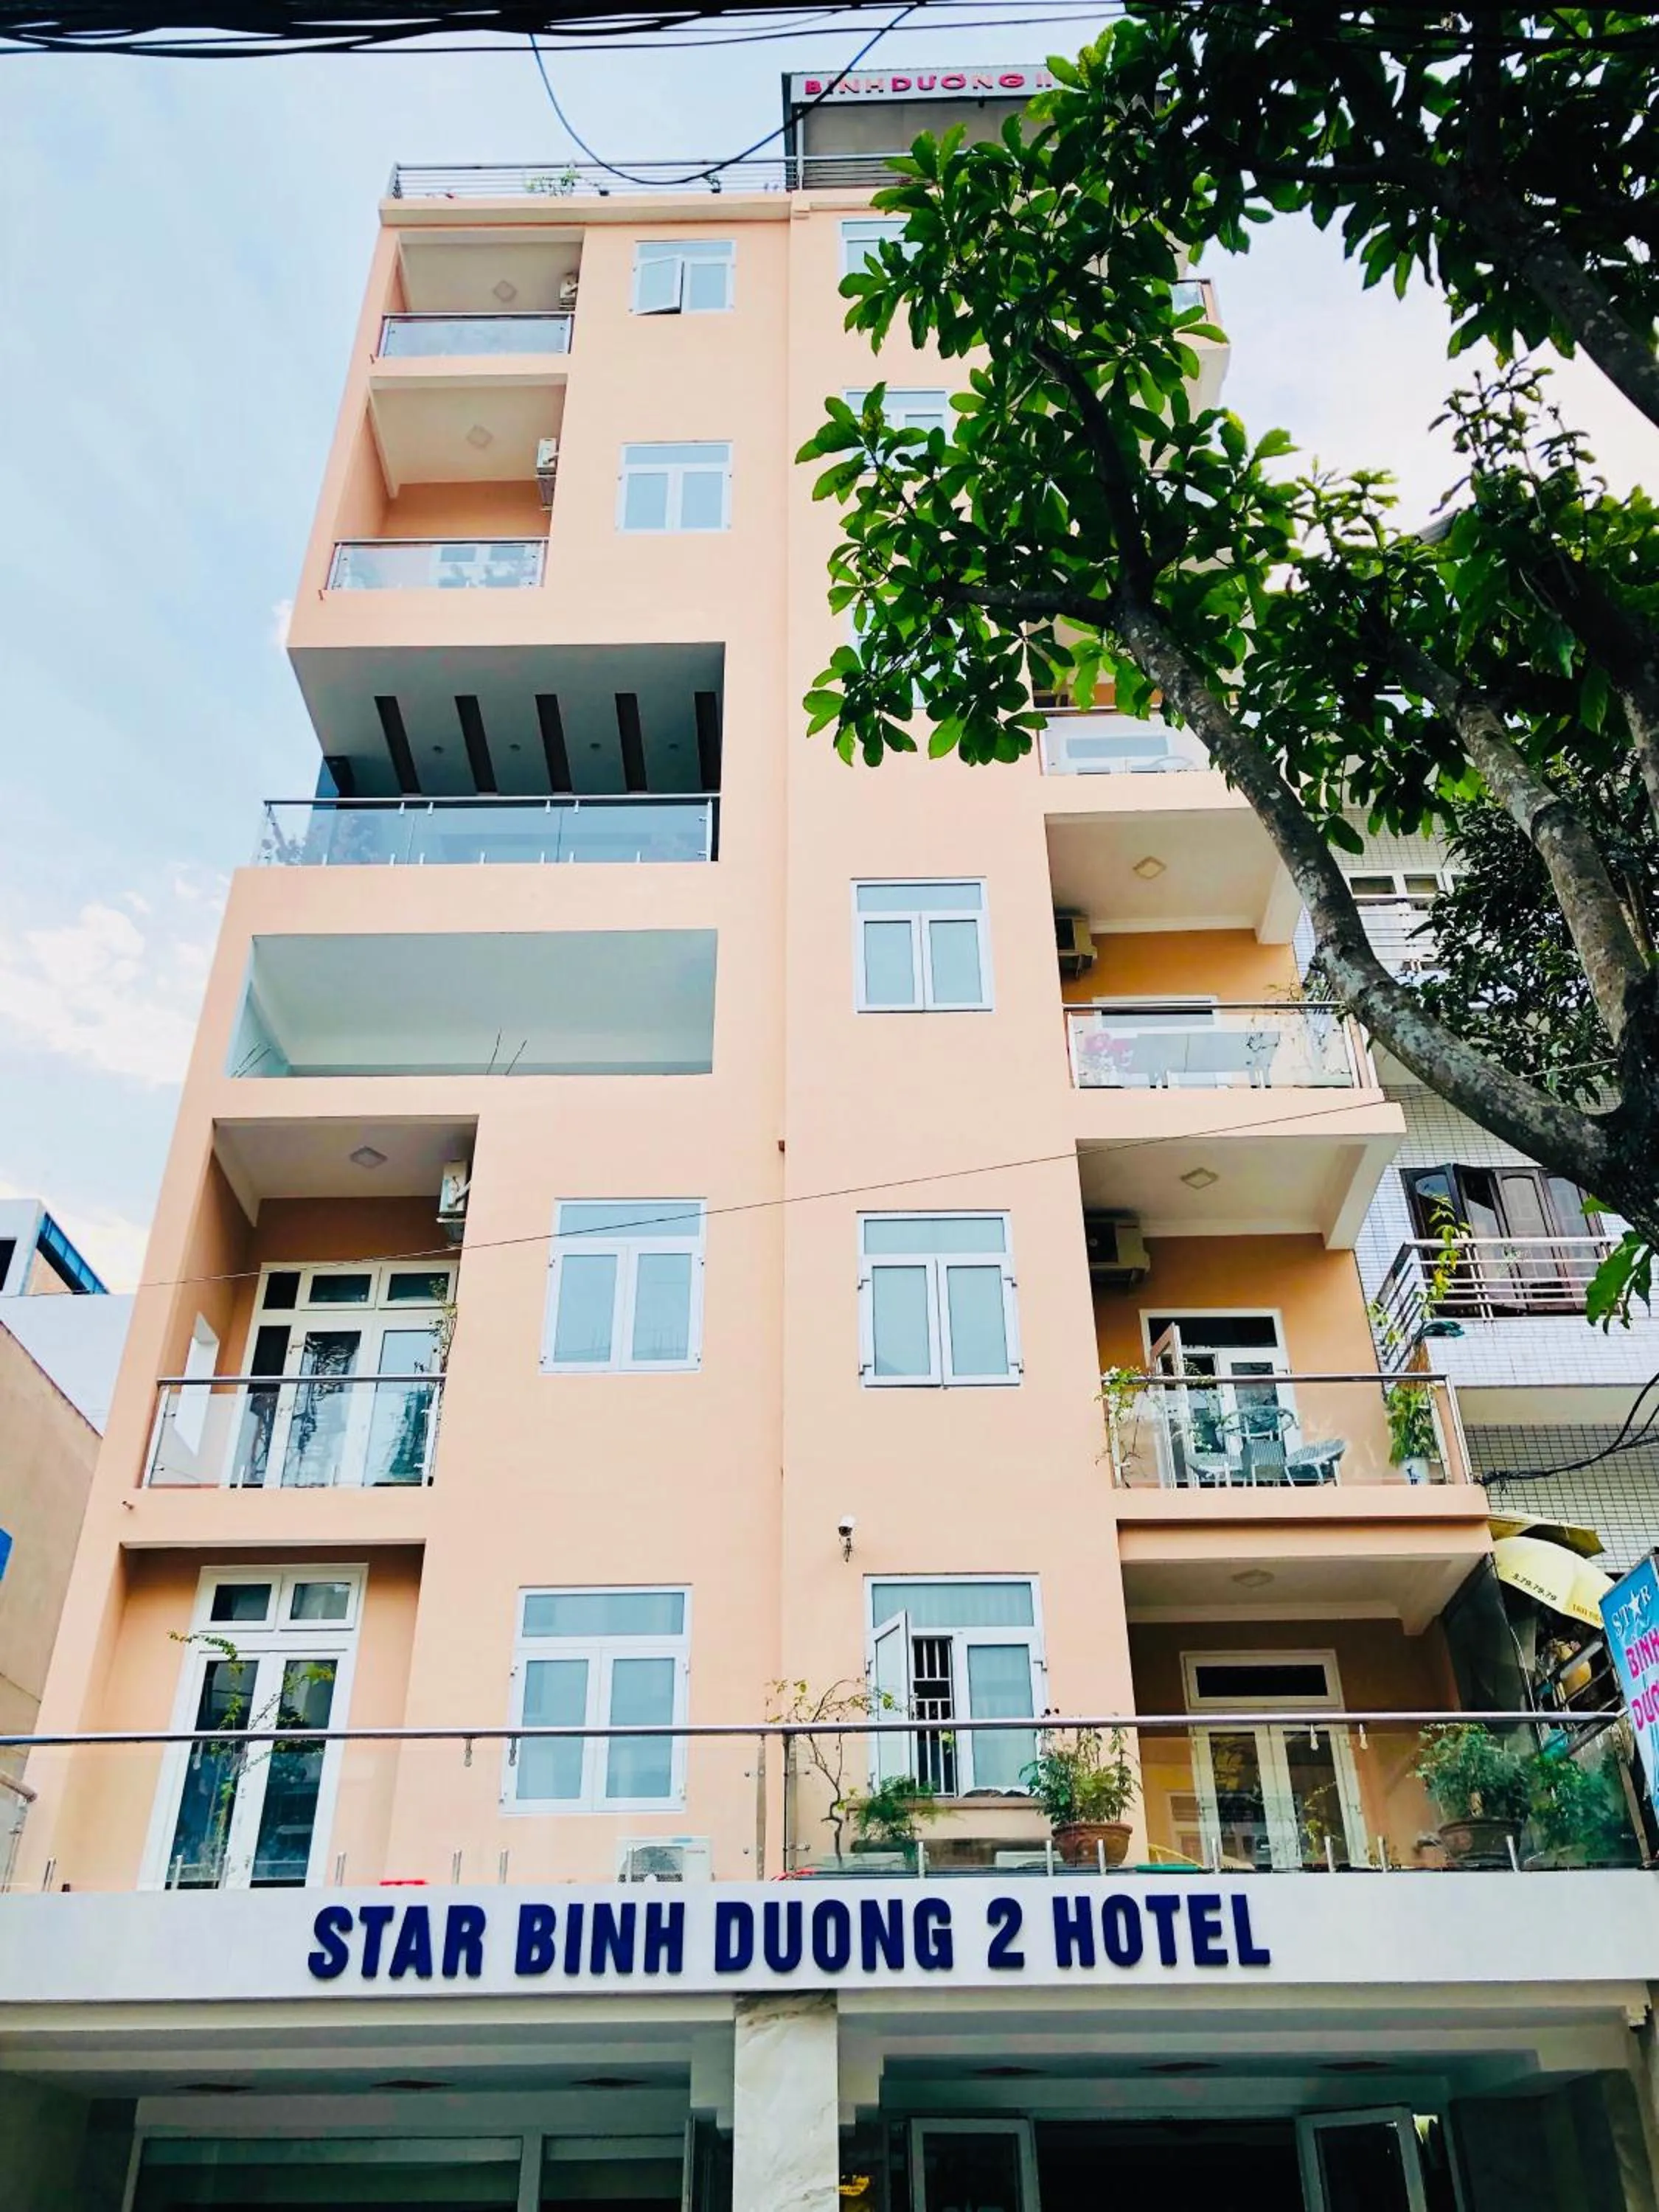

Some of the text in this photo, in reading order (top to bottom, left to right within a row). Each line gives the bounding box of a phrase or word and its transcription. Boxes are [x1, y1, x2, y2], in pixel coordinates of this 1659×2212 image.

[307, 1894, 1270, 1978] STAR BINH DUONG 2 HOTEL
